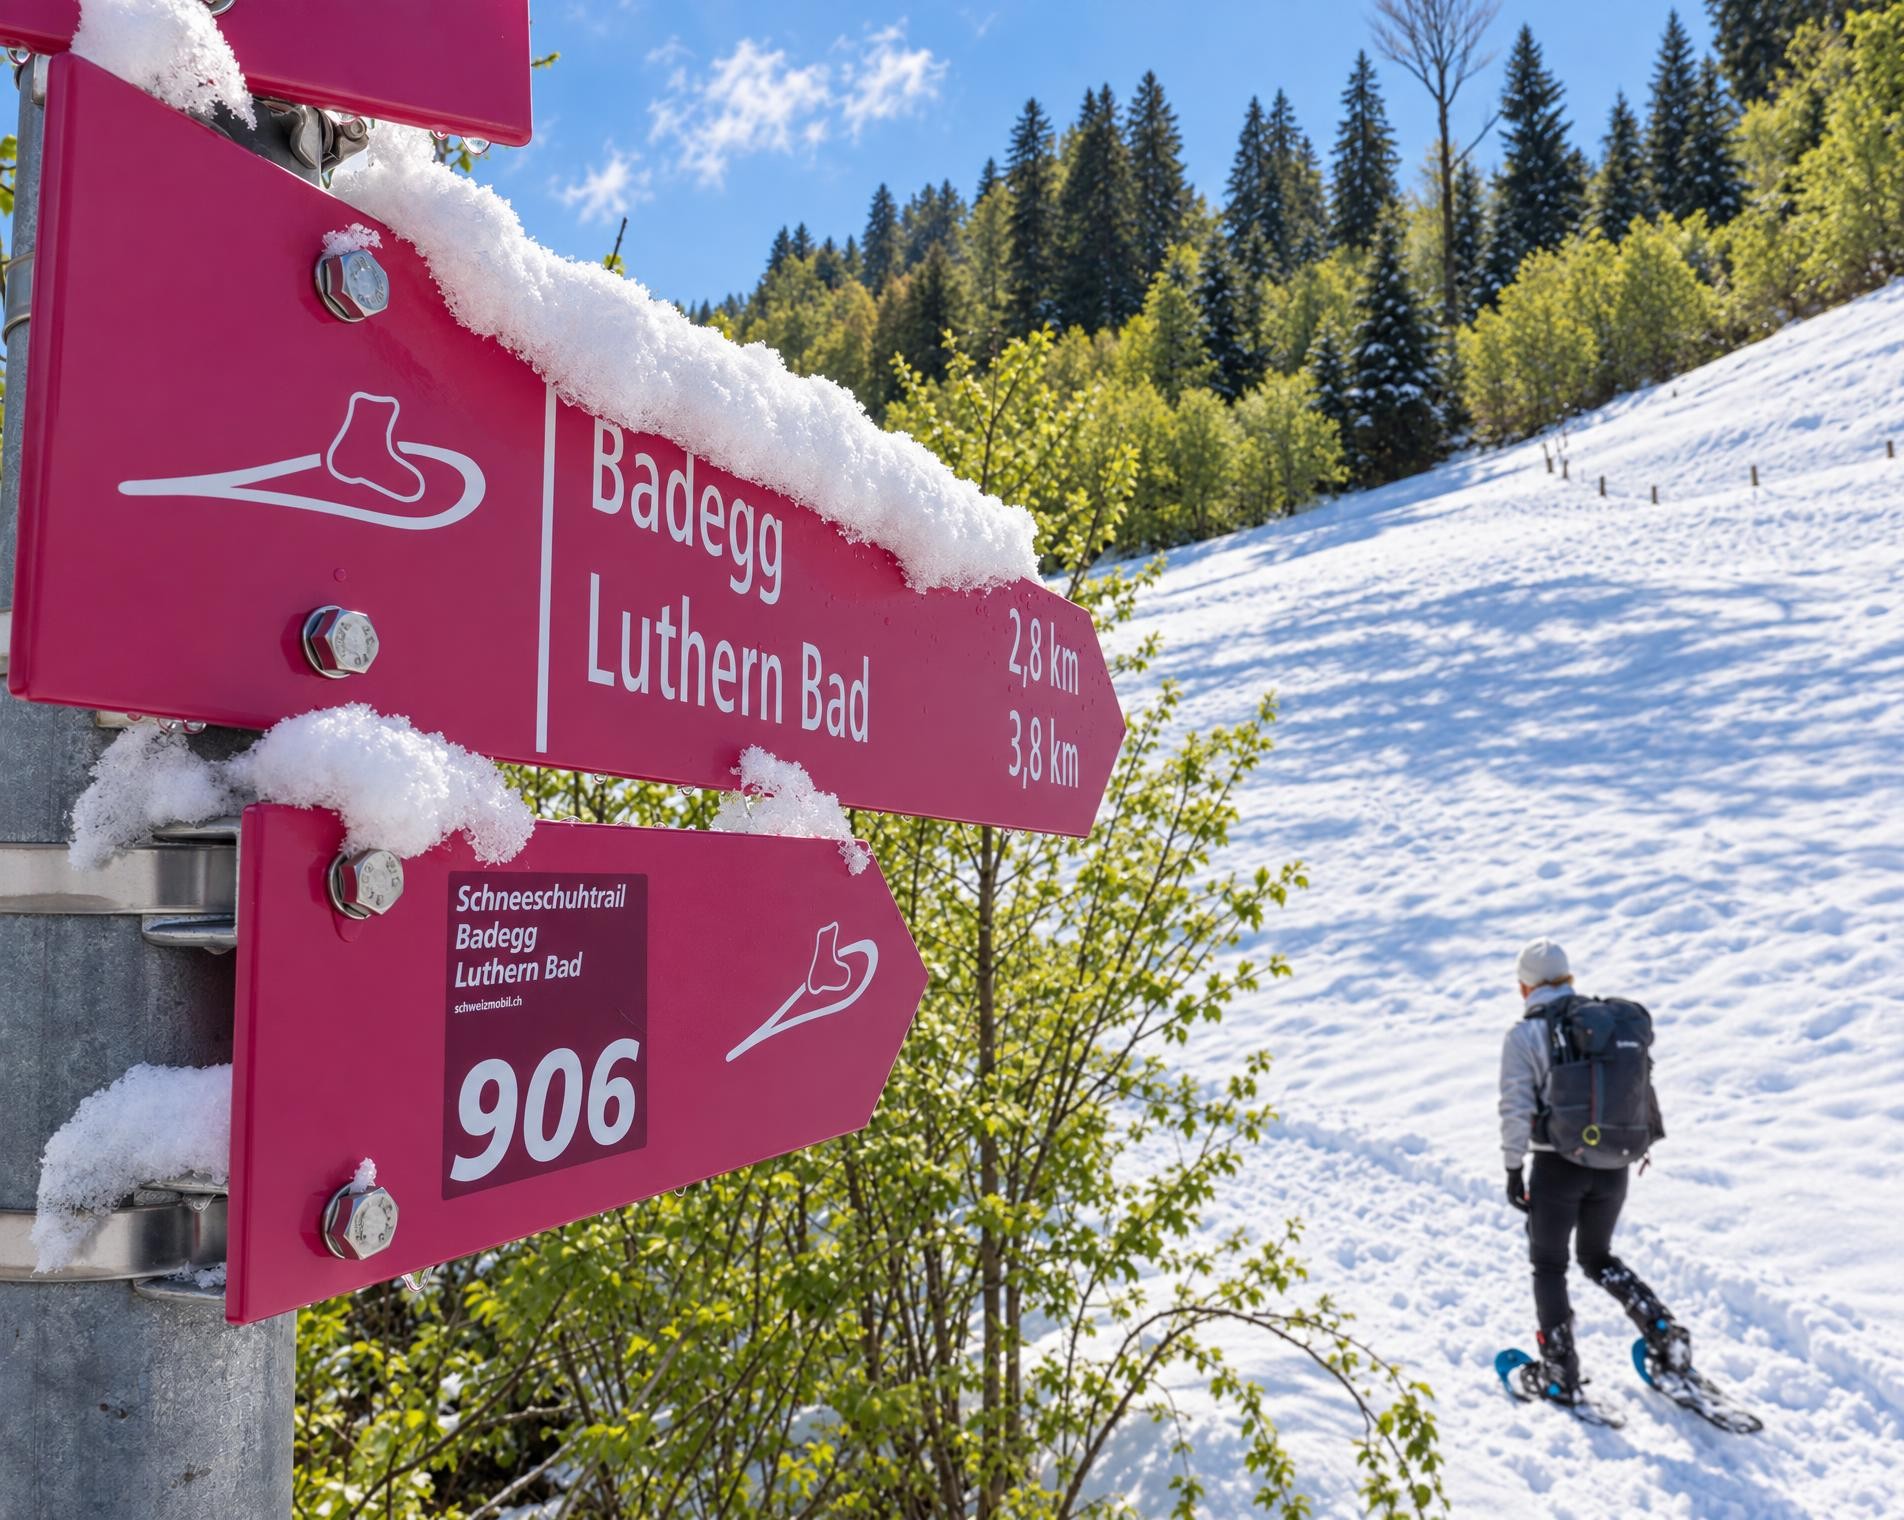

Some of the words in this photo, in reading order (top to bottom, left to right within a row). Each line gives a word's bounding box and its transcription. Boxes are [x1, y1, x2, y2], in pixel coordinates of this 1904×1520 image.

[592, 418, 782, 605] Badegg
[587, 572, 783, 725] Luthern
[801, 641, 869, 743] Bad
[1009, 608, 1042, 688] 2,8
[1050, 622, 1079, 695] km
[1009, 709, 1042, 789] 3,8
[1050, 717, 1079, 788] km
[455, 921, 538, 953] Badegg
[456, 883, 627, 912] Schneeschuhtrail
[454, 957, 539, 988] Luthern
[544, 951, 583, 980] Bad
[454, 996, 523, 1014] schweizmobil.ch
[450, 1037, 640, 1182] 906
